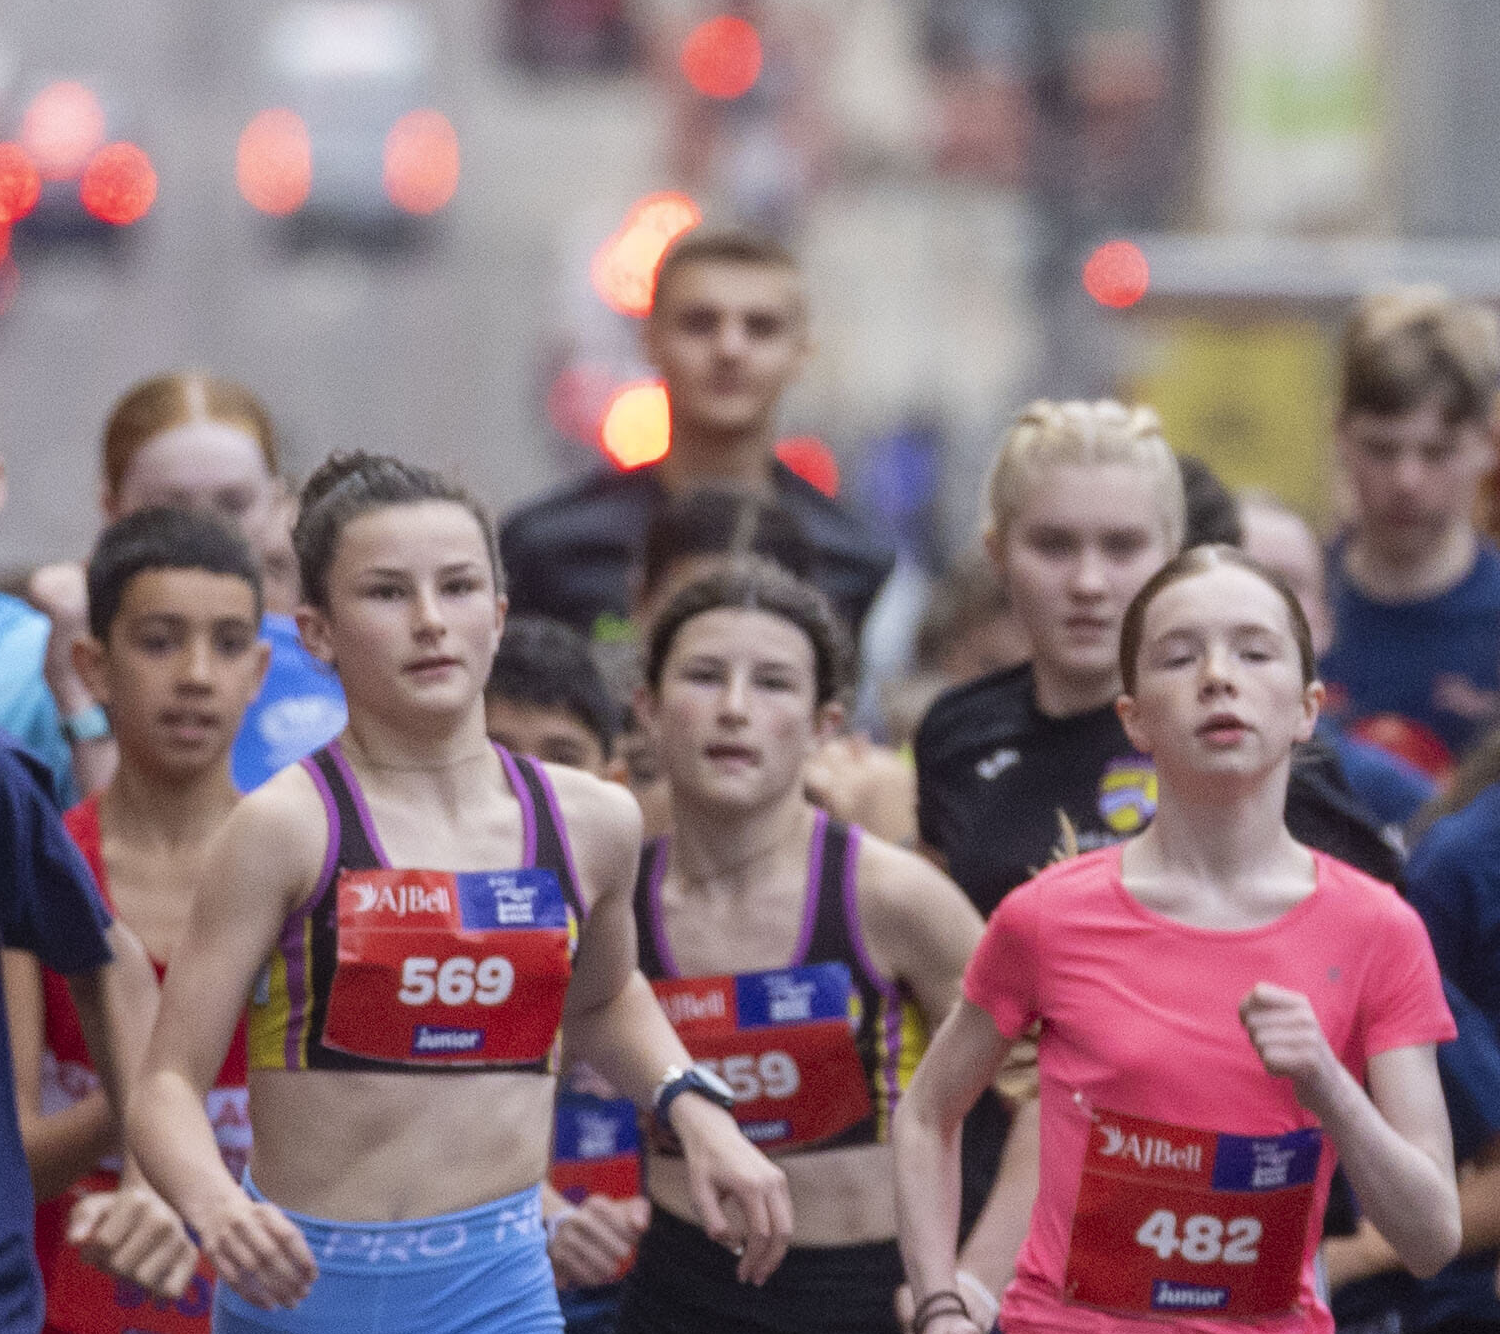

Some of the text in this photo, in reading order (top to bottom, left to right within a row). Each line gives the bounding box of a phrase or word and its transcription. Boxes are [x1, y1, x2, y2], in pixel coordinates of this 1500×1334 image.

[375, 886, 451, 917] AJBell
[396, 955, 516, 1007] 569
[1122, 1131, 1202, 1172] AJBell
[321, 1223, 467, 1263] PRO
[1135, 1208, 1264, 1264] 482
